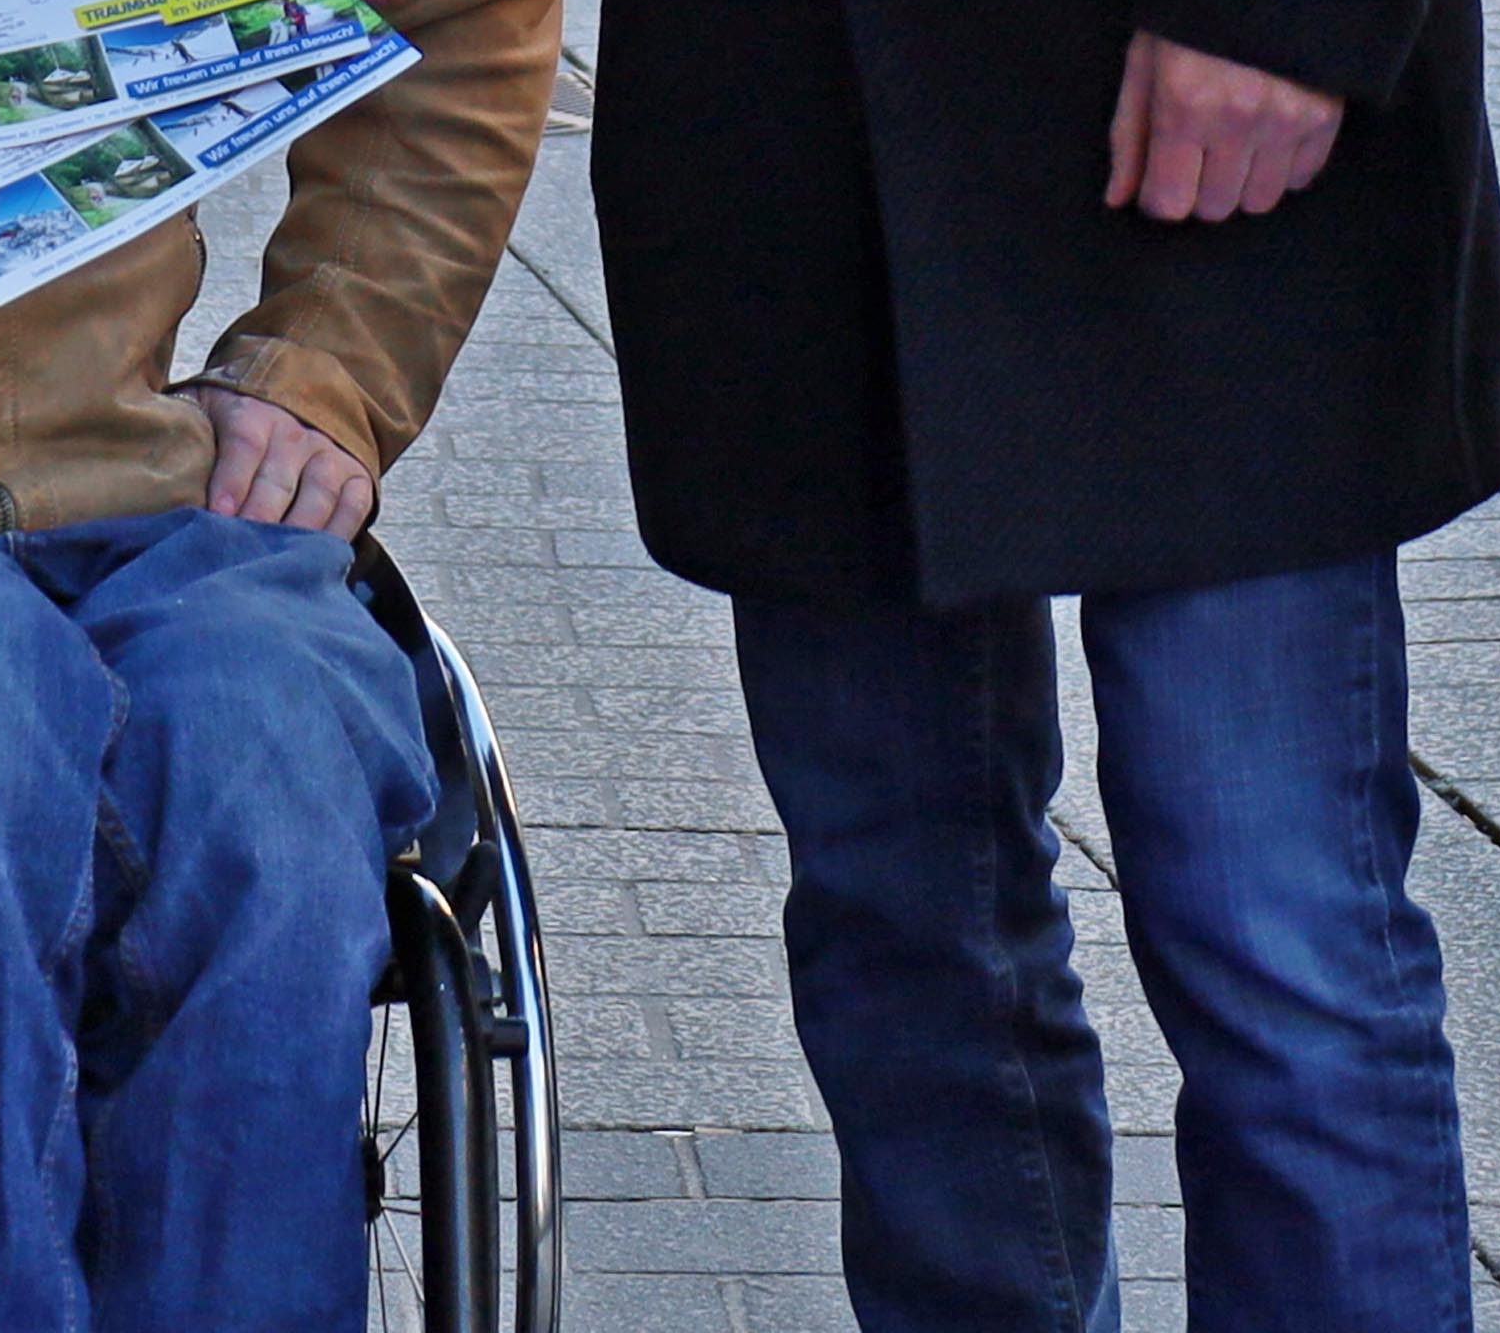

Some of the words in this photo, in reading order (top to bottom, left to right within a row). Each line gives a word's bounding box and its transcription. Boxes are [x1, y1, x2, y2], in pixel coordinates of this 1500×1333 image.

[133, 79, 159, 96] Wir
[163, 66, 208, 88] freuen
[210, 58, 236, 76] uns
[239, 50, 262, 68] auf
[264, 42, 300, 62] Ihren
[302, 25, 354, 49] Besuch!
[206, 143, 231, 163] Wir
[231, 117, 274, 150] freuen
[274, 104, 298, 128] uns
[298, 87, 321, 108] auf
[321, 71, 352, 96] Ihren
[350, 39, 398, 77] Besuch!
